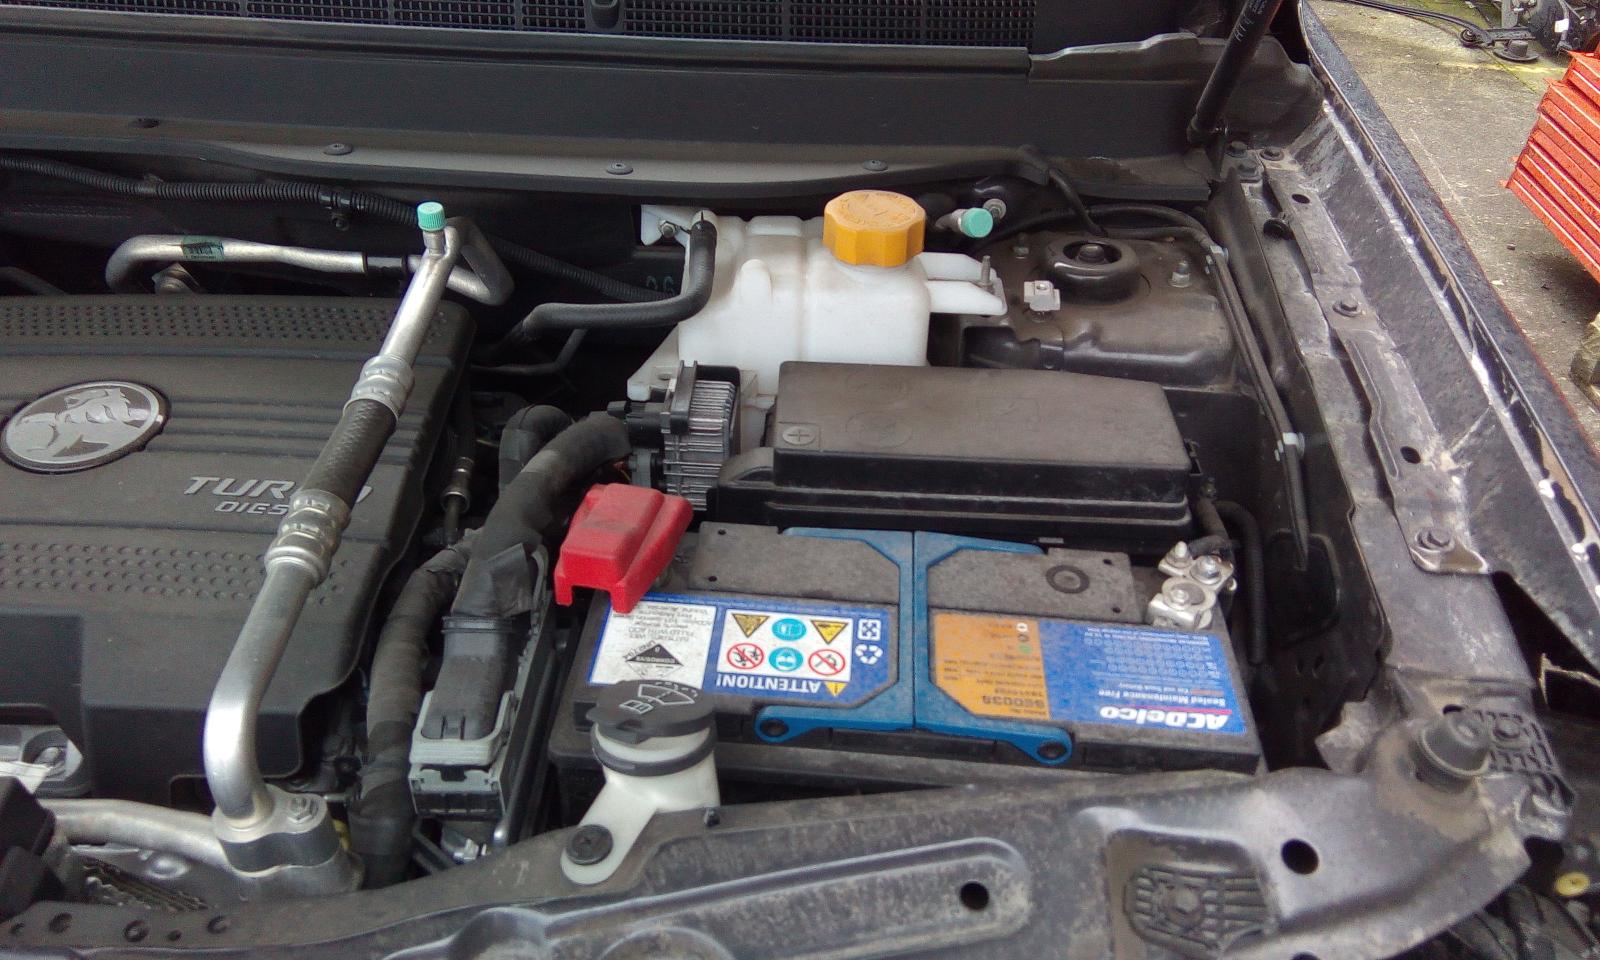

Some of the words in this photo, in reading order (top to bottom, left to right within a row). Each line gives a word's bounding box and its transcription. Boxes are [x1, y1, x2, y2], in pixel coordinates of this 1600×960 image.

[716, 674, 821, 693] ATTENTION!
[1098, 688, 1121, 699] Free
[1123, 690, 1189, 705] Maintenance
[1191, 696, 1226, 707] Sealed
[1100, 705, 1230, 730] ACDelco
